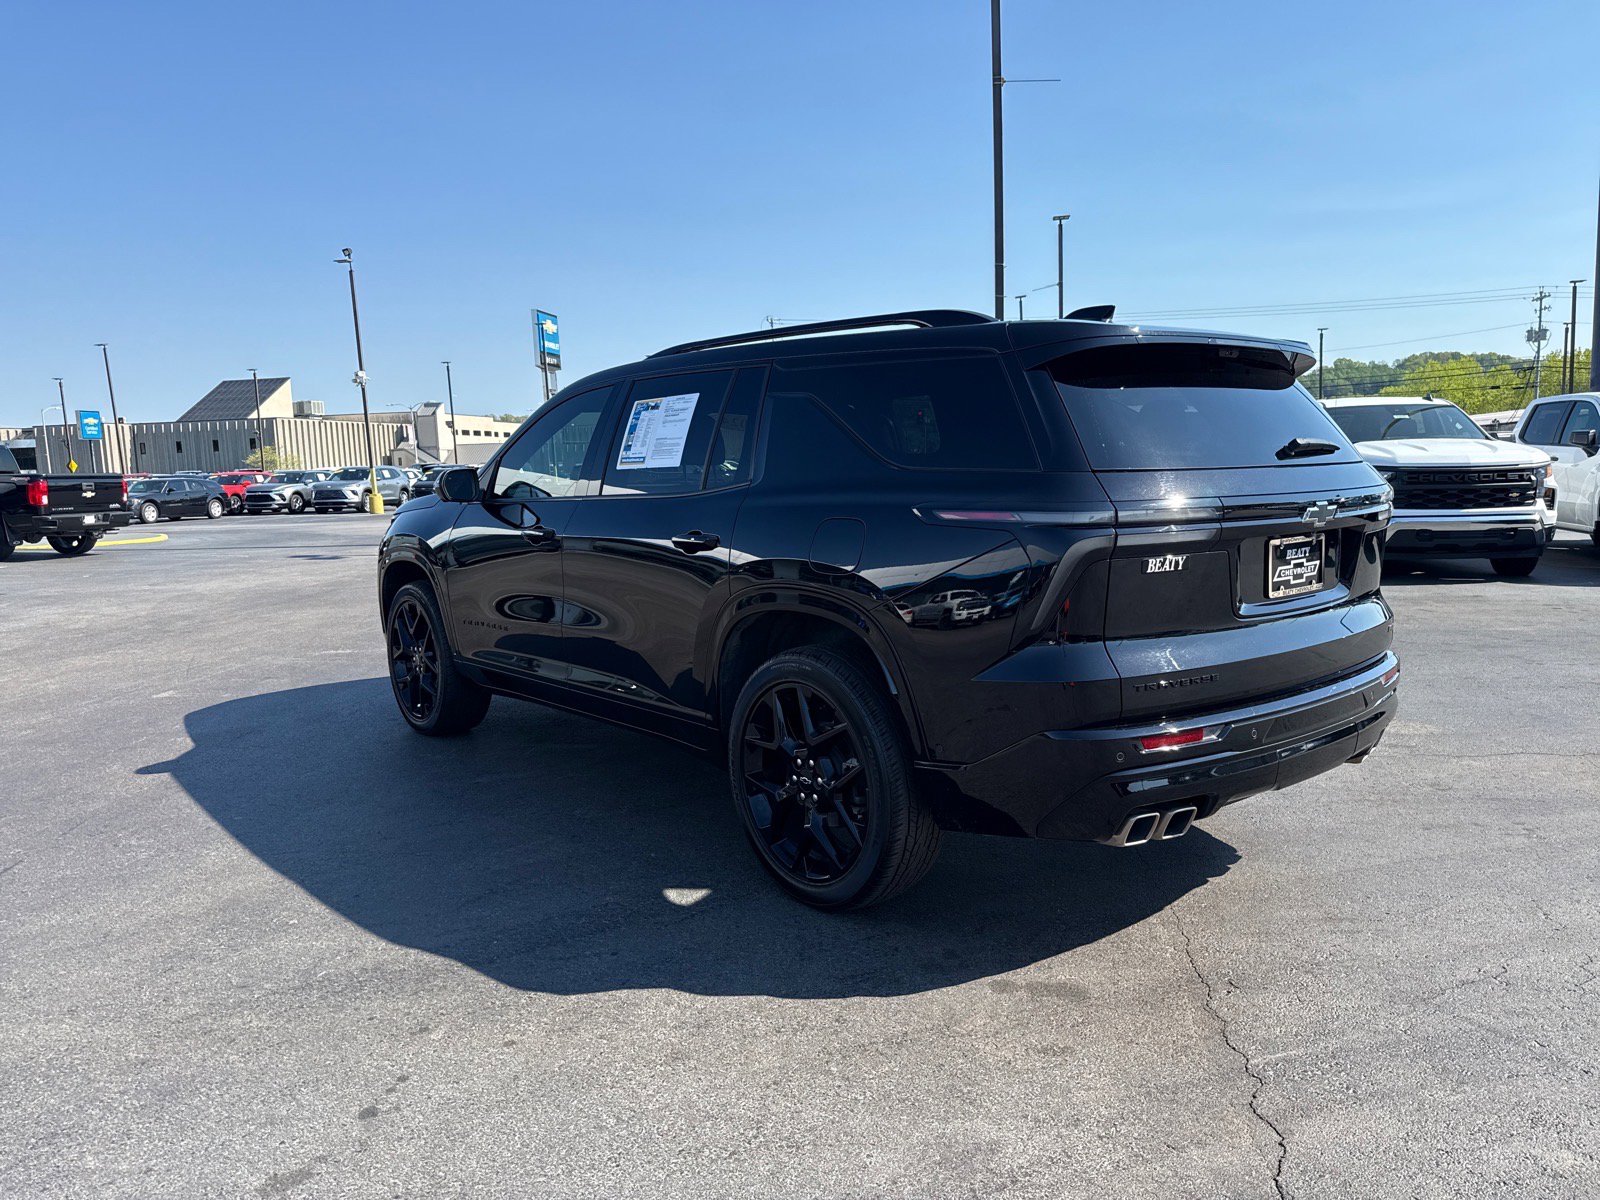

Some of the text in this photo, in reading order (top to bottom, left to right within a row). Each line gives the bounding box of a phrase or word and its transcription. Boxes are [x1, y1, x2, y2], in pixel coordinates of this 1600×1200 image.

[1404, 471, 1532, 483] CHEVROLET
[1285, 546, 1311, 560] BEATY
[1146, 555, 1187, 573] BEATY
[1280, 565, 1315, 577] CHEVROLET
[1132, 673, 1220, 693] TRAVERSE
